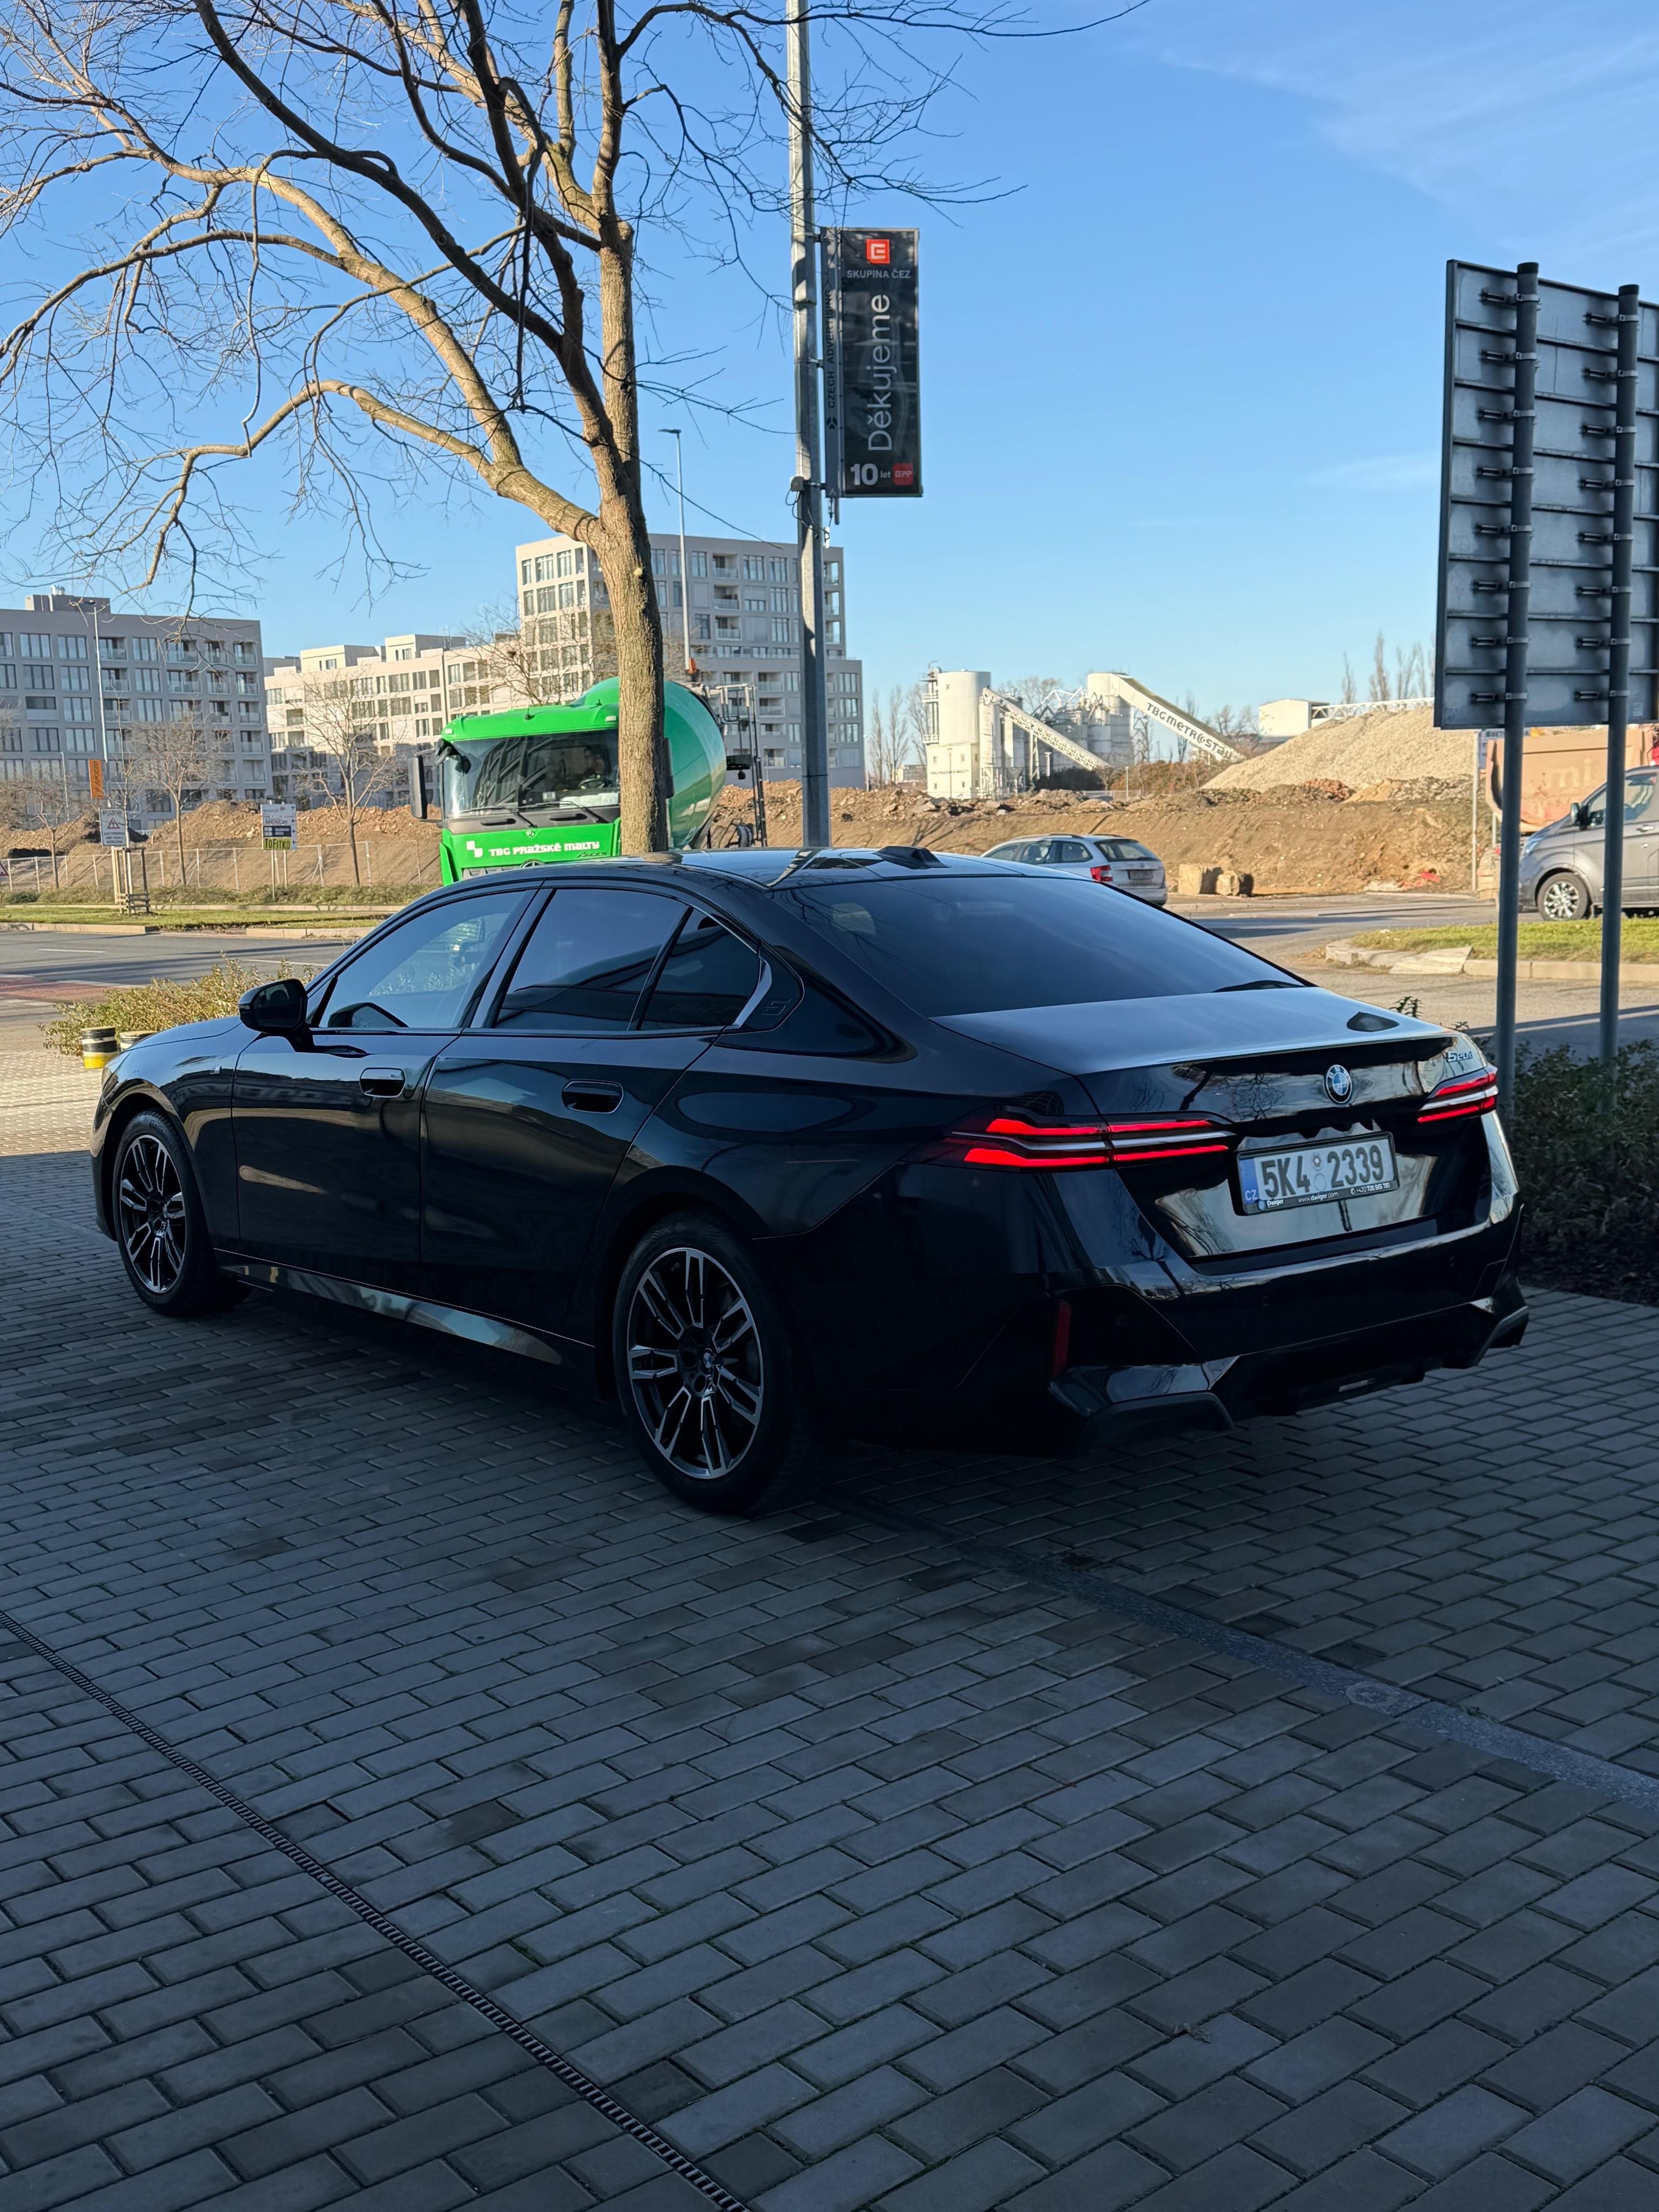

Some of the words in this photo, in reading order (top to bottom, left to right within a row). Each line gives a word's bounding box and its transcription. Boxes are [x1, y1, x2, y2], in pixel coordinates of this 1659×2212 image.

[847, 269, 889, 278] SKUPINA
[892, 268, 911, 279] ČEZ
[825, 289, 834, 363] ADVERTISING
[866, 294, 897, 451] Děkujeme
[850, 463, 879, 485] 10
[1146, 703, 1166, 720] TBG
[489, 848, 510, 857] TBG
[1260, 1156, 1311, 1198] 5K4
[1327, 1144, 1384, 1188] 2339
[1244, 1189, 1258, 1201] CZ
[1266, 1199, 1284, 1207] Dwiger
[1297, 1192, 1339, 1203] www.dwiger.com
